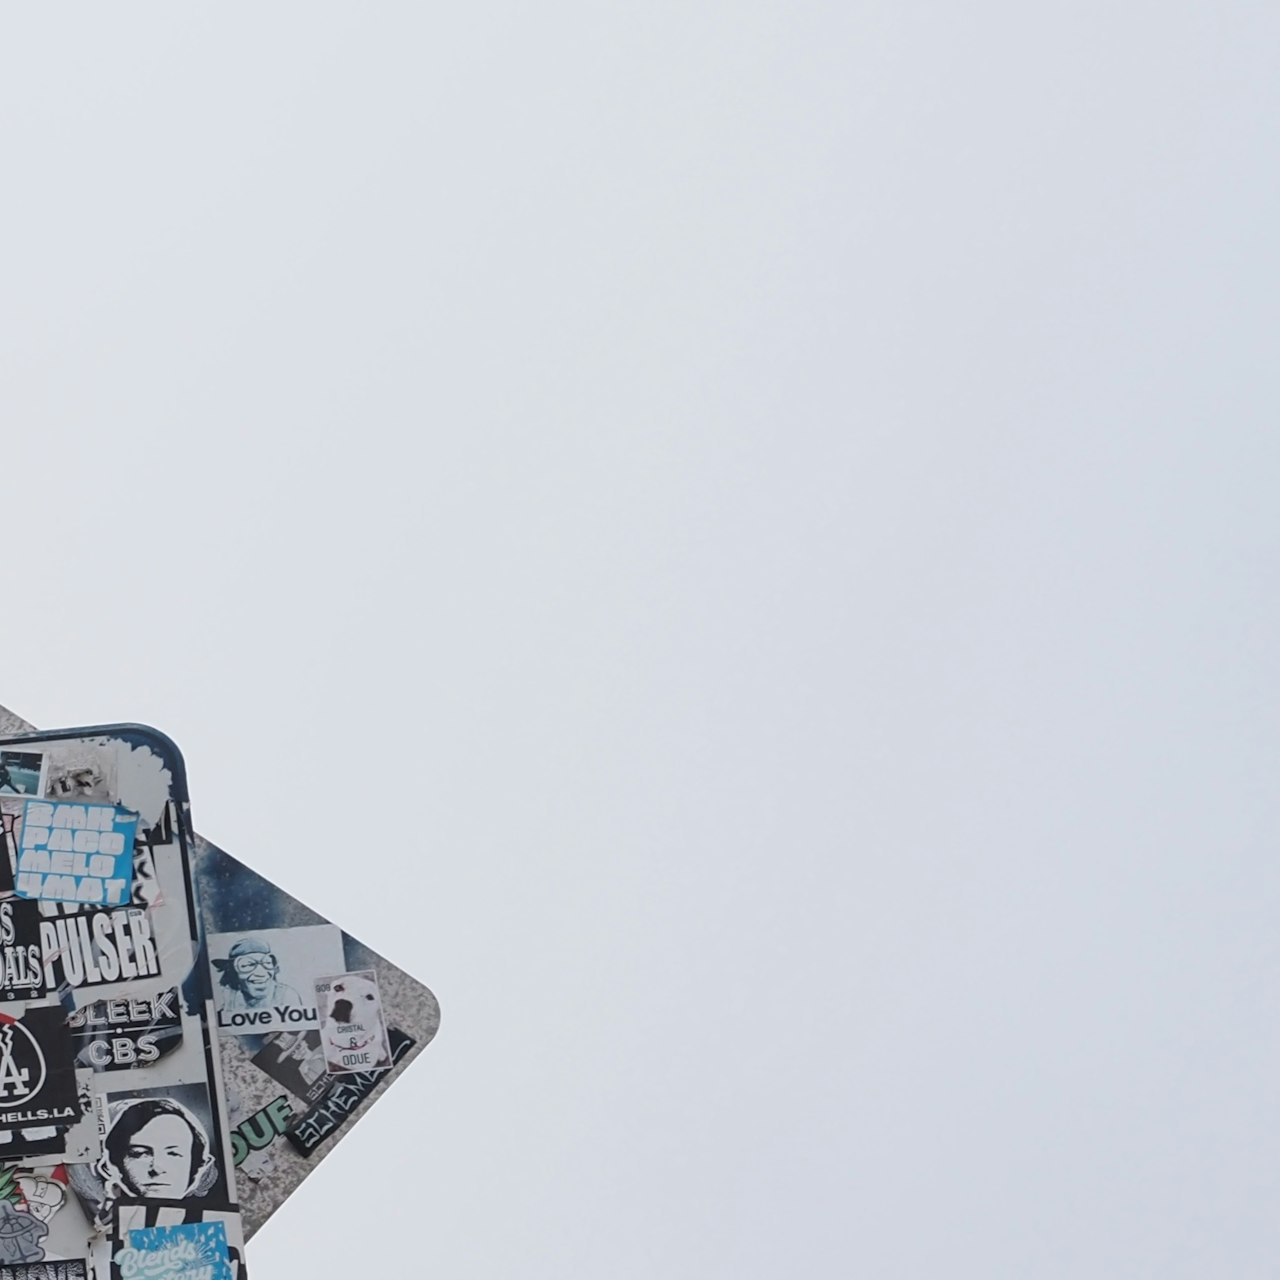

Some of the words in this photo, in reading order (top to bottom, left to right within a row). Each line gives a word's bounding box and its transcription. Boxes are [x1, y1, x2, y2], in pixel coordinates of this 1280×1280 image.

[39, 909, 159, 989] PULSER
[217, 1006, 272, 1028] Love
[274, 1005, 318, 1023] You
[89, 1035, 161, 1066] CBS
[114, 1239, 198, 1278] Blends
